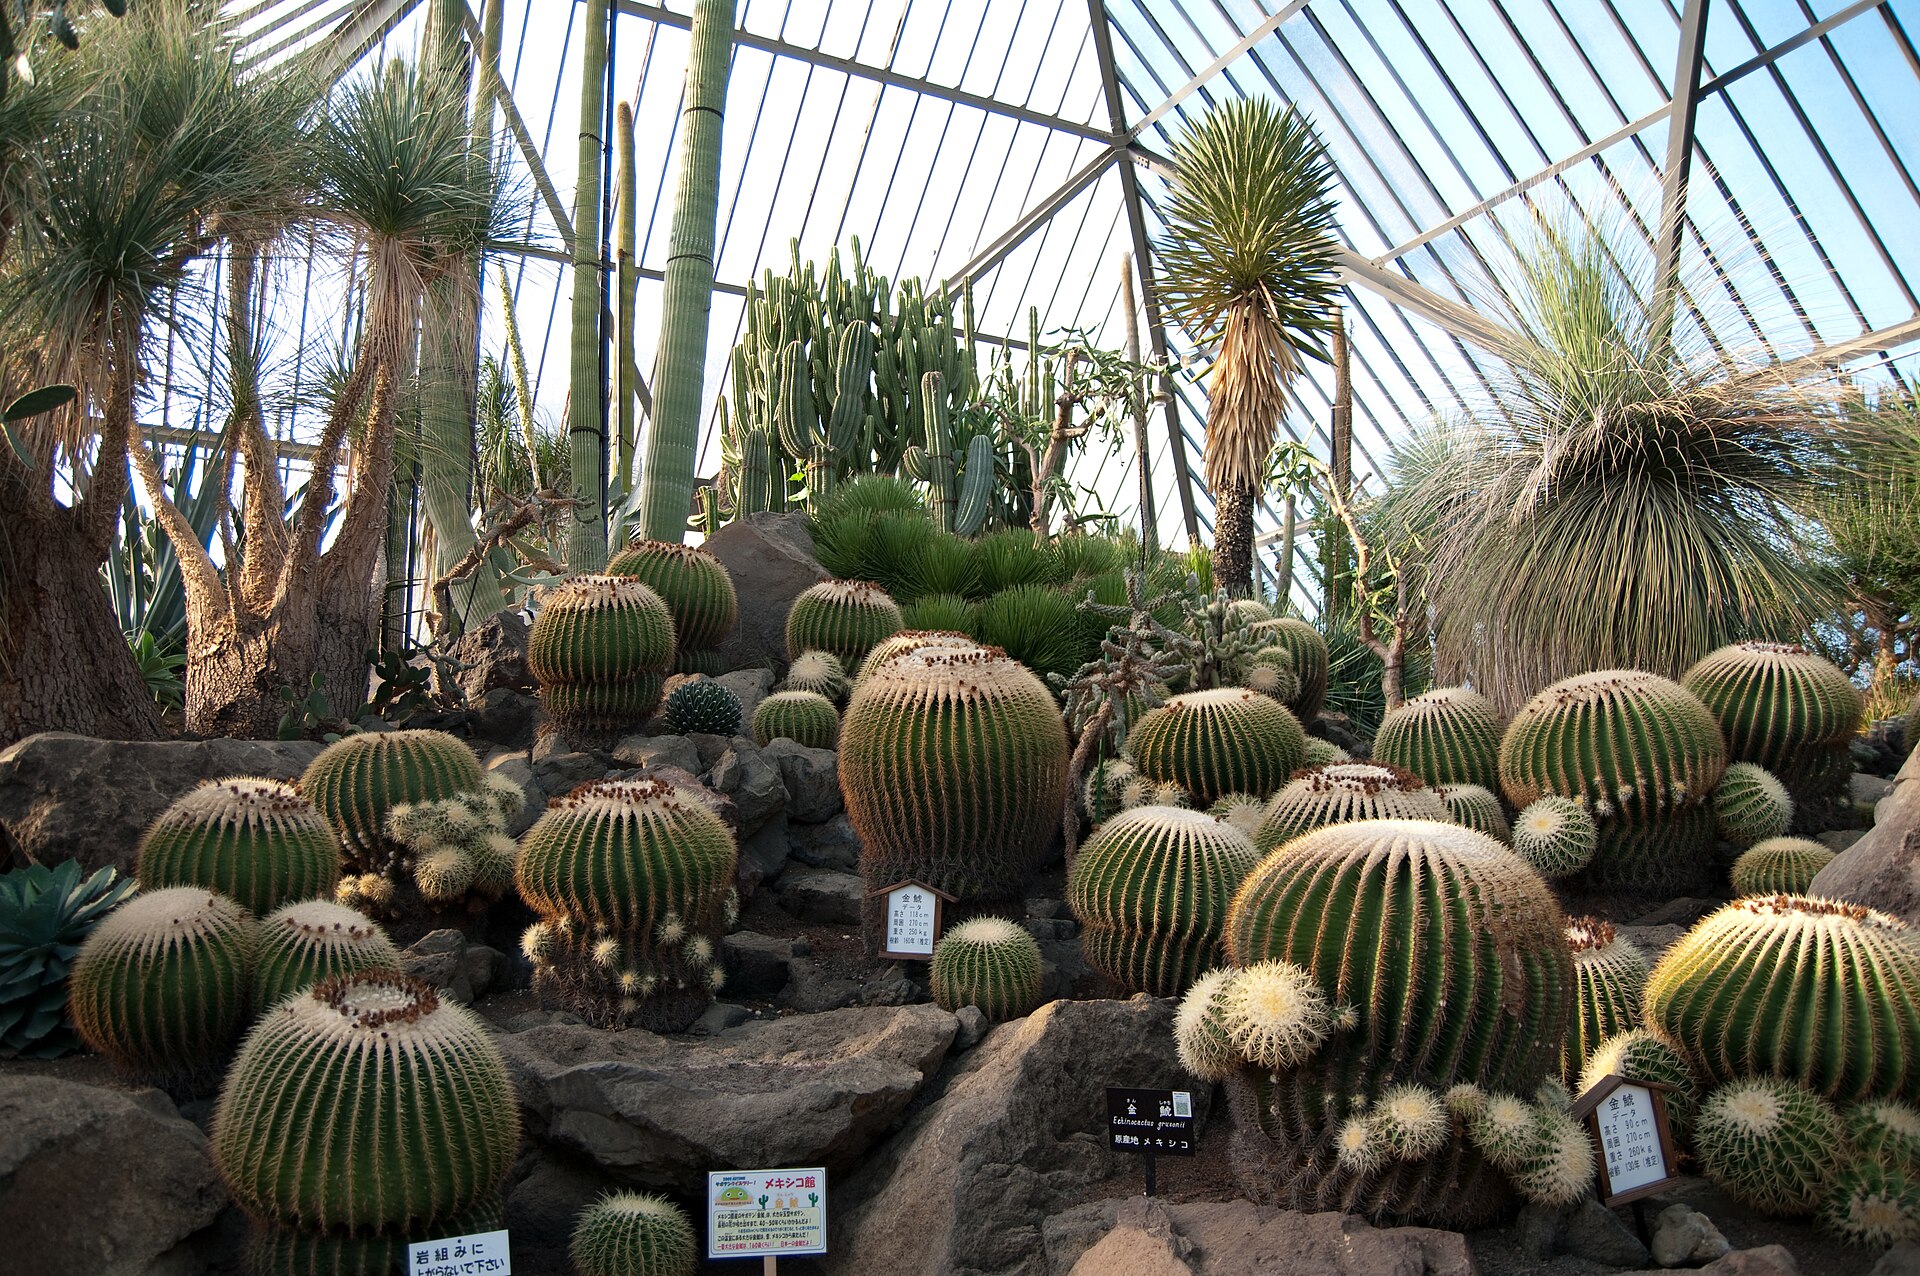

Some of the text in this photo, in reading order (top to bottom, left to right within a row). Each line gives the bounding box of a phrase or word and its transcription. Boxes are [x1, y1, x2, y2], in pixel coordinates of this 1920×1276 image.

[893, 910, 904, 918] 高さ
[1612, 1109, 1636, 1121] データ
[1113, 1115, 1185, 1131] Echinocactus grusonii
[1603, 1118, 1648, 1136] 高さ 90cm
[1115, 1134, 1188, 1149] 原産地 メキシコ
[1625, 1131, 1651, 1144] 270cm
[1609, 1145, 1653, 1163] 重さ 260kg
[765, 1176, 816, 1189] メキシコ館
[416, 1243, 484, 1265] 岩組みに
[417, 1258, 505, 1276] 上がらないで下さい
